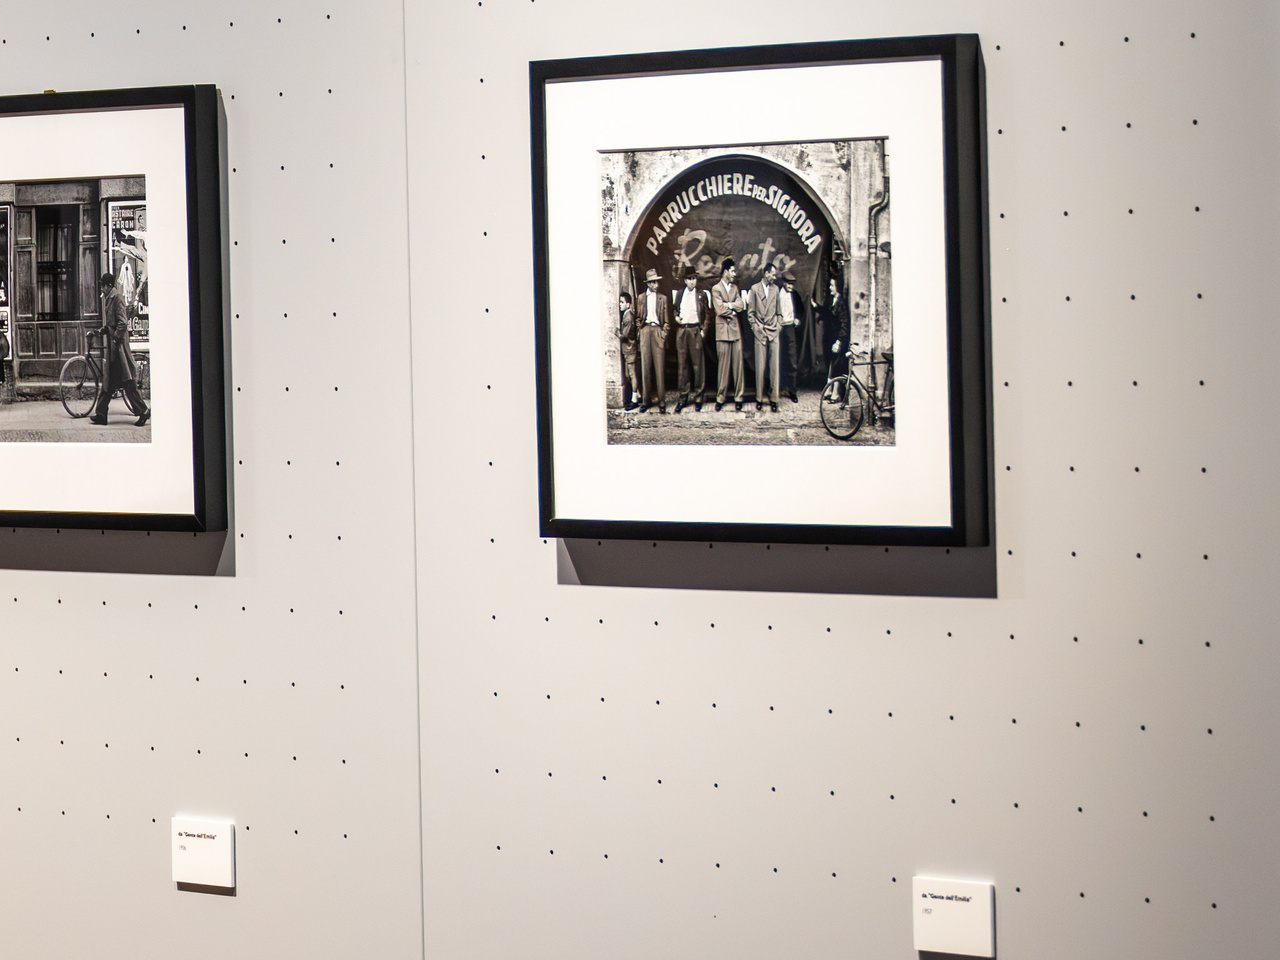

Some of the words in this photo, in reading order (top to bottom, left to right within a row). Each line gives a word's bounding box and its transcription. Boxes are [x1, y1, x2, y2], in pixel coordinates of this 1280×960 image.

[646, 172, 756, 256] PARRUCCHIERE
[751, 184, 768, 202] PER
[764, 184, 822, 254] SIGNORA
